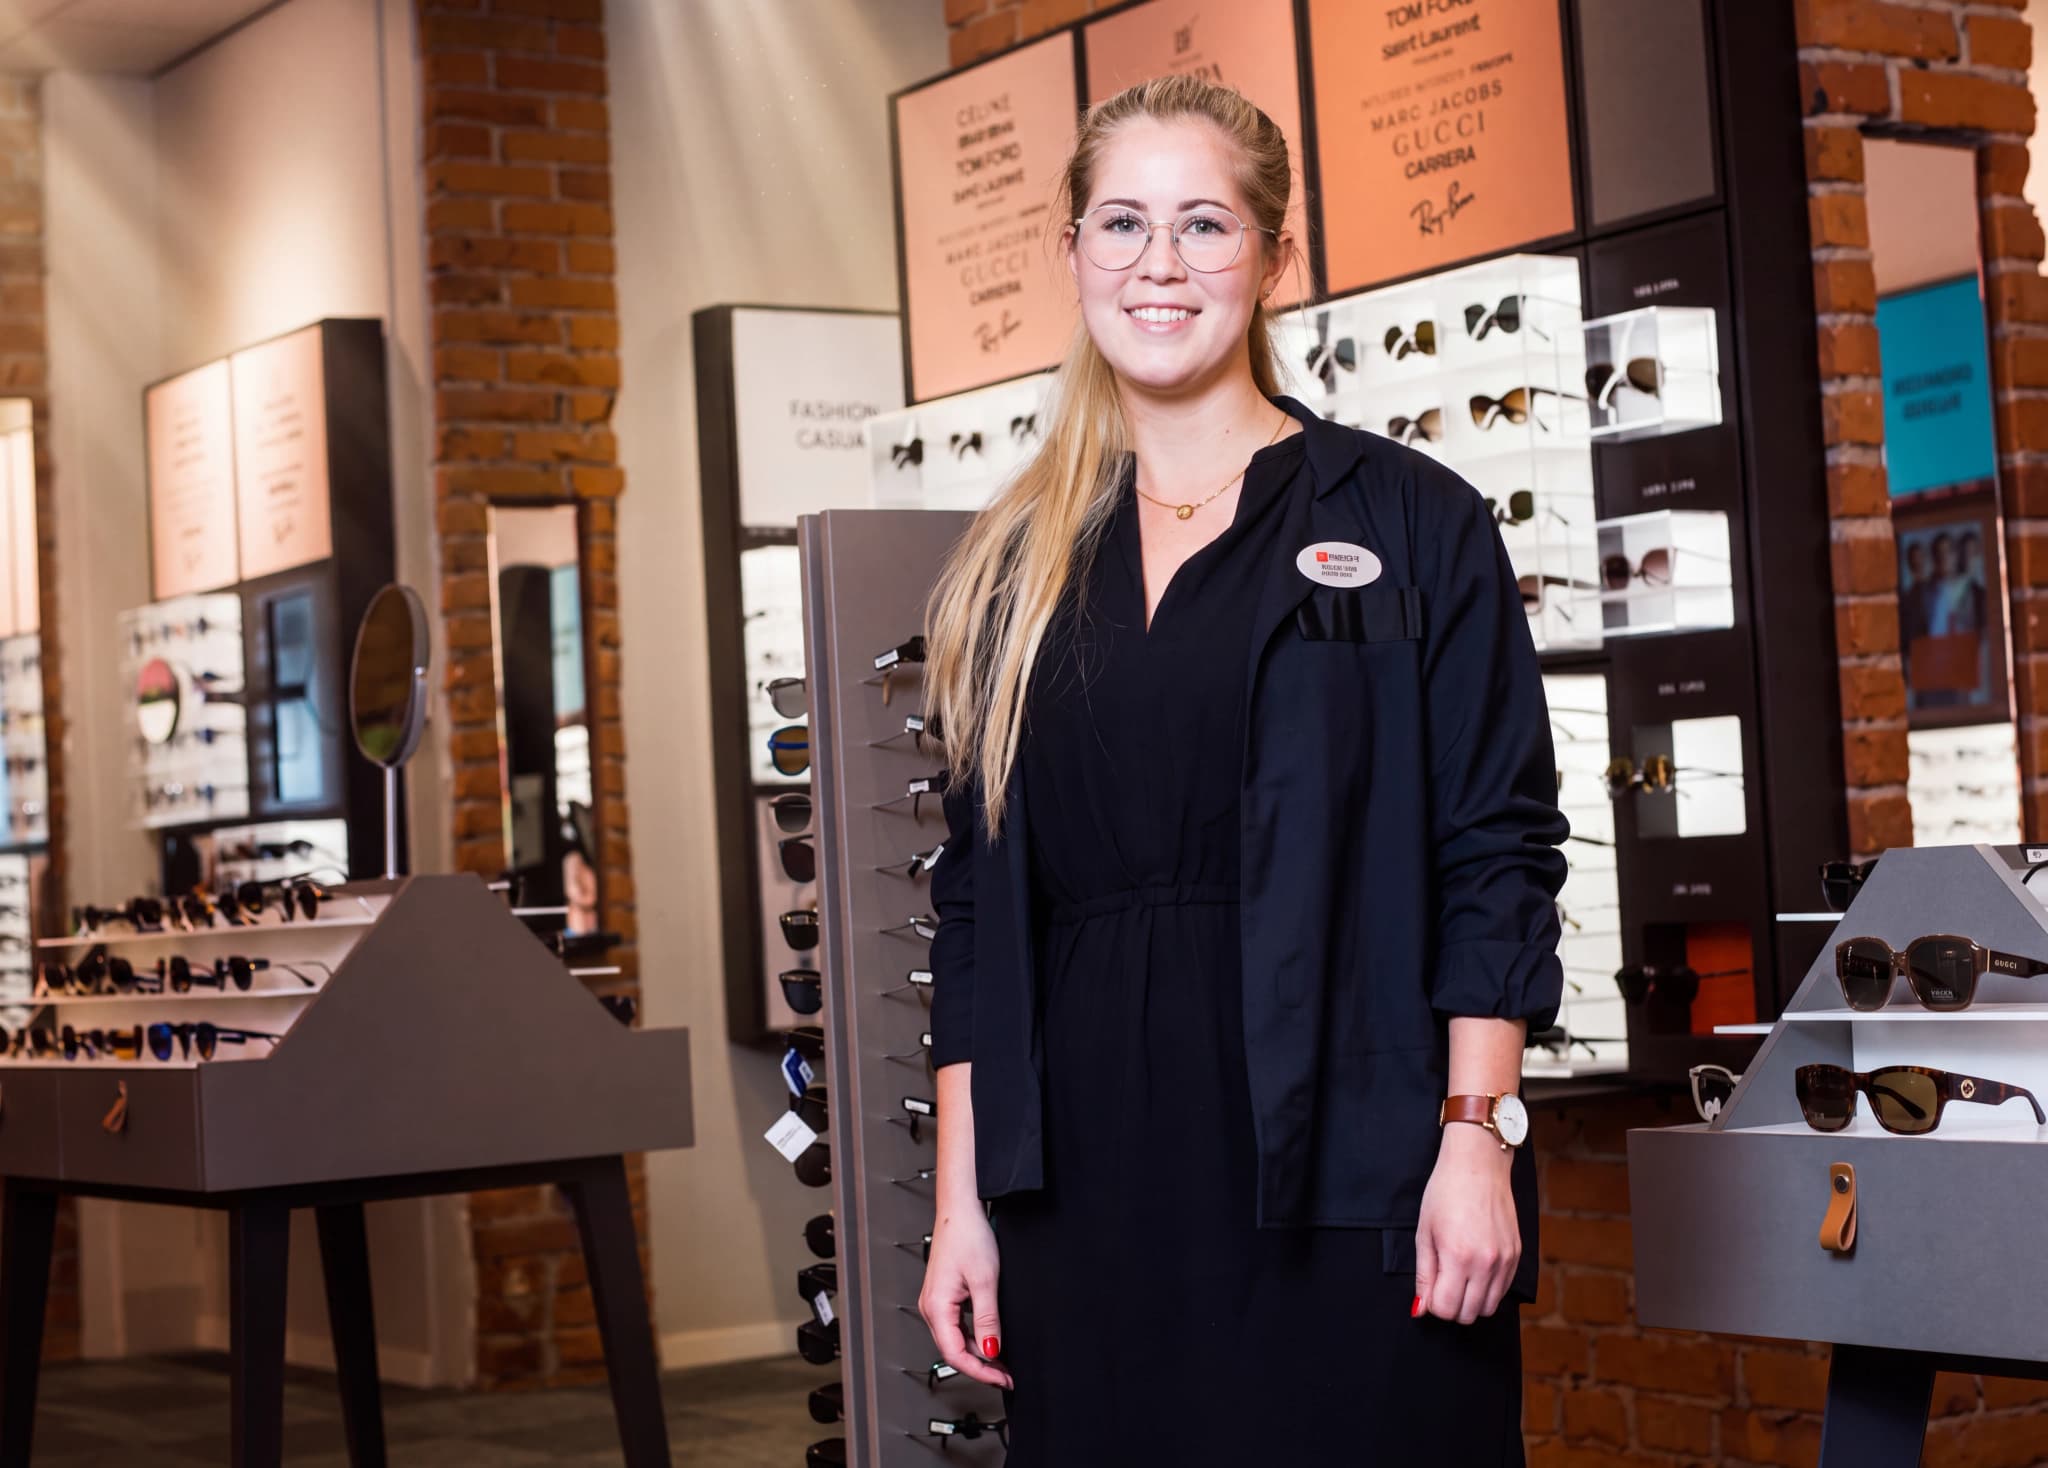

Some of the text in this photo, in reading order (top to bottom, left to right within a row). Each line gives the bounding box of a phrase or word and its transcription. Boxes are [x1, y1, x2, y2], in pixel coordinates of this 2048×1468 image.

[1385, 0, 1475, 30] TOM FOR
[1370, 104, 1421, 132] MARC
[1429, 80, 1503, 116] JACOBS
[1392, 109, 1485, 157] GUCCI
[1404, 145, 1476, 180] CARRERA
[789, 399, 880, 421] FASHION
[796, 428, 865, 451] CASUA
[1994, 959, 2017, 969] GUCCI
